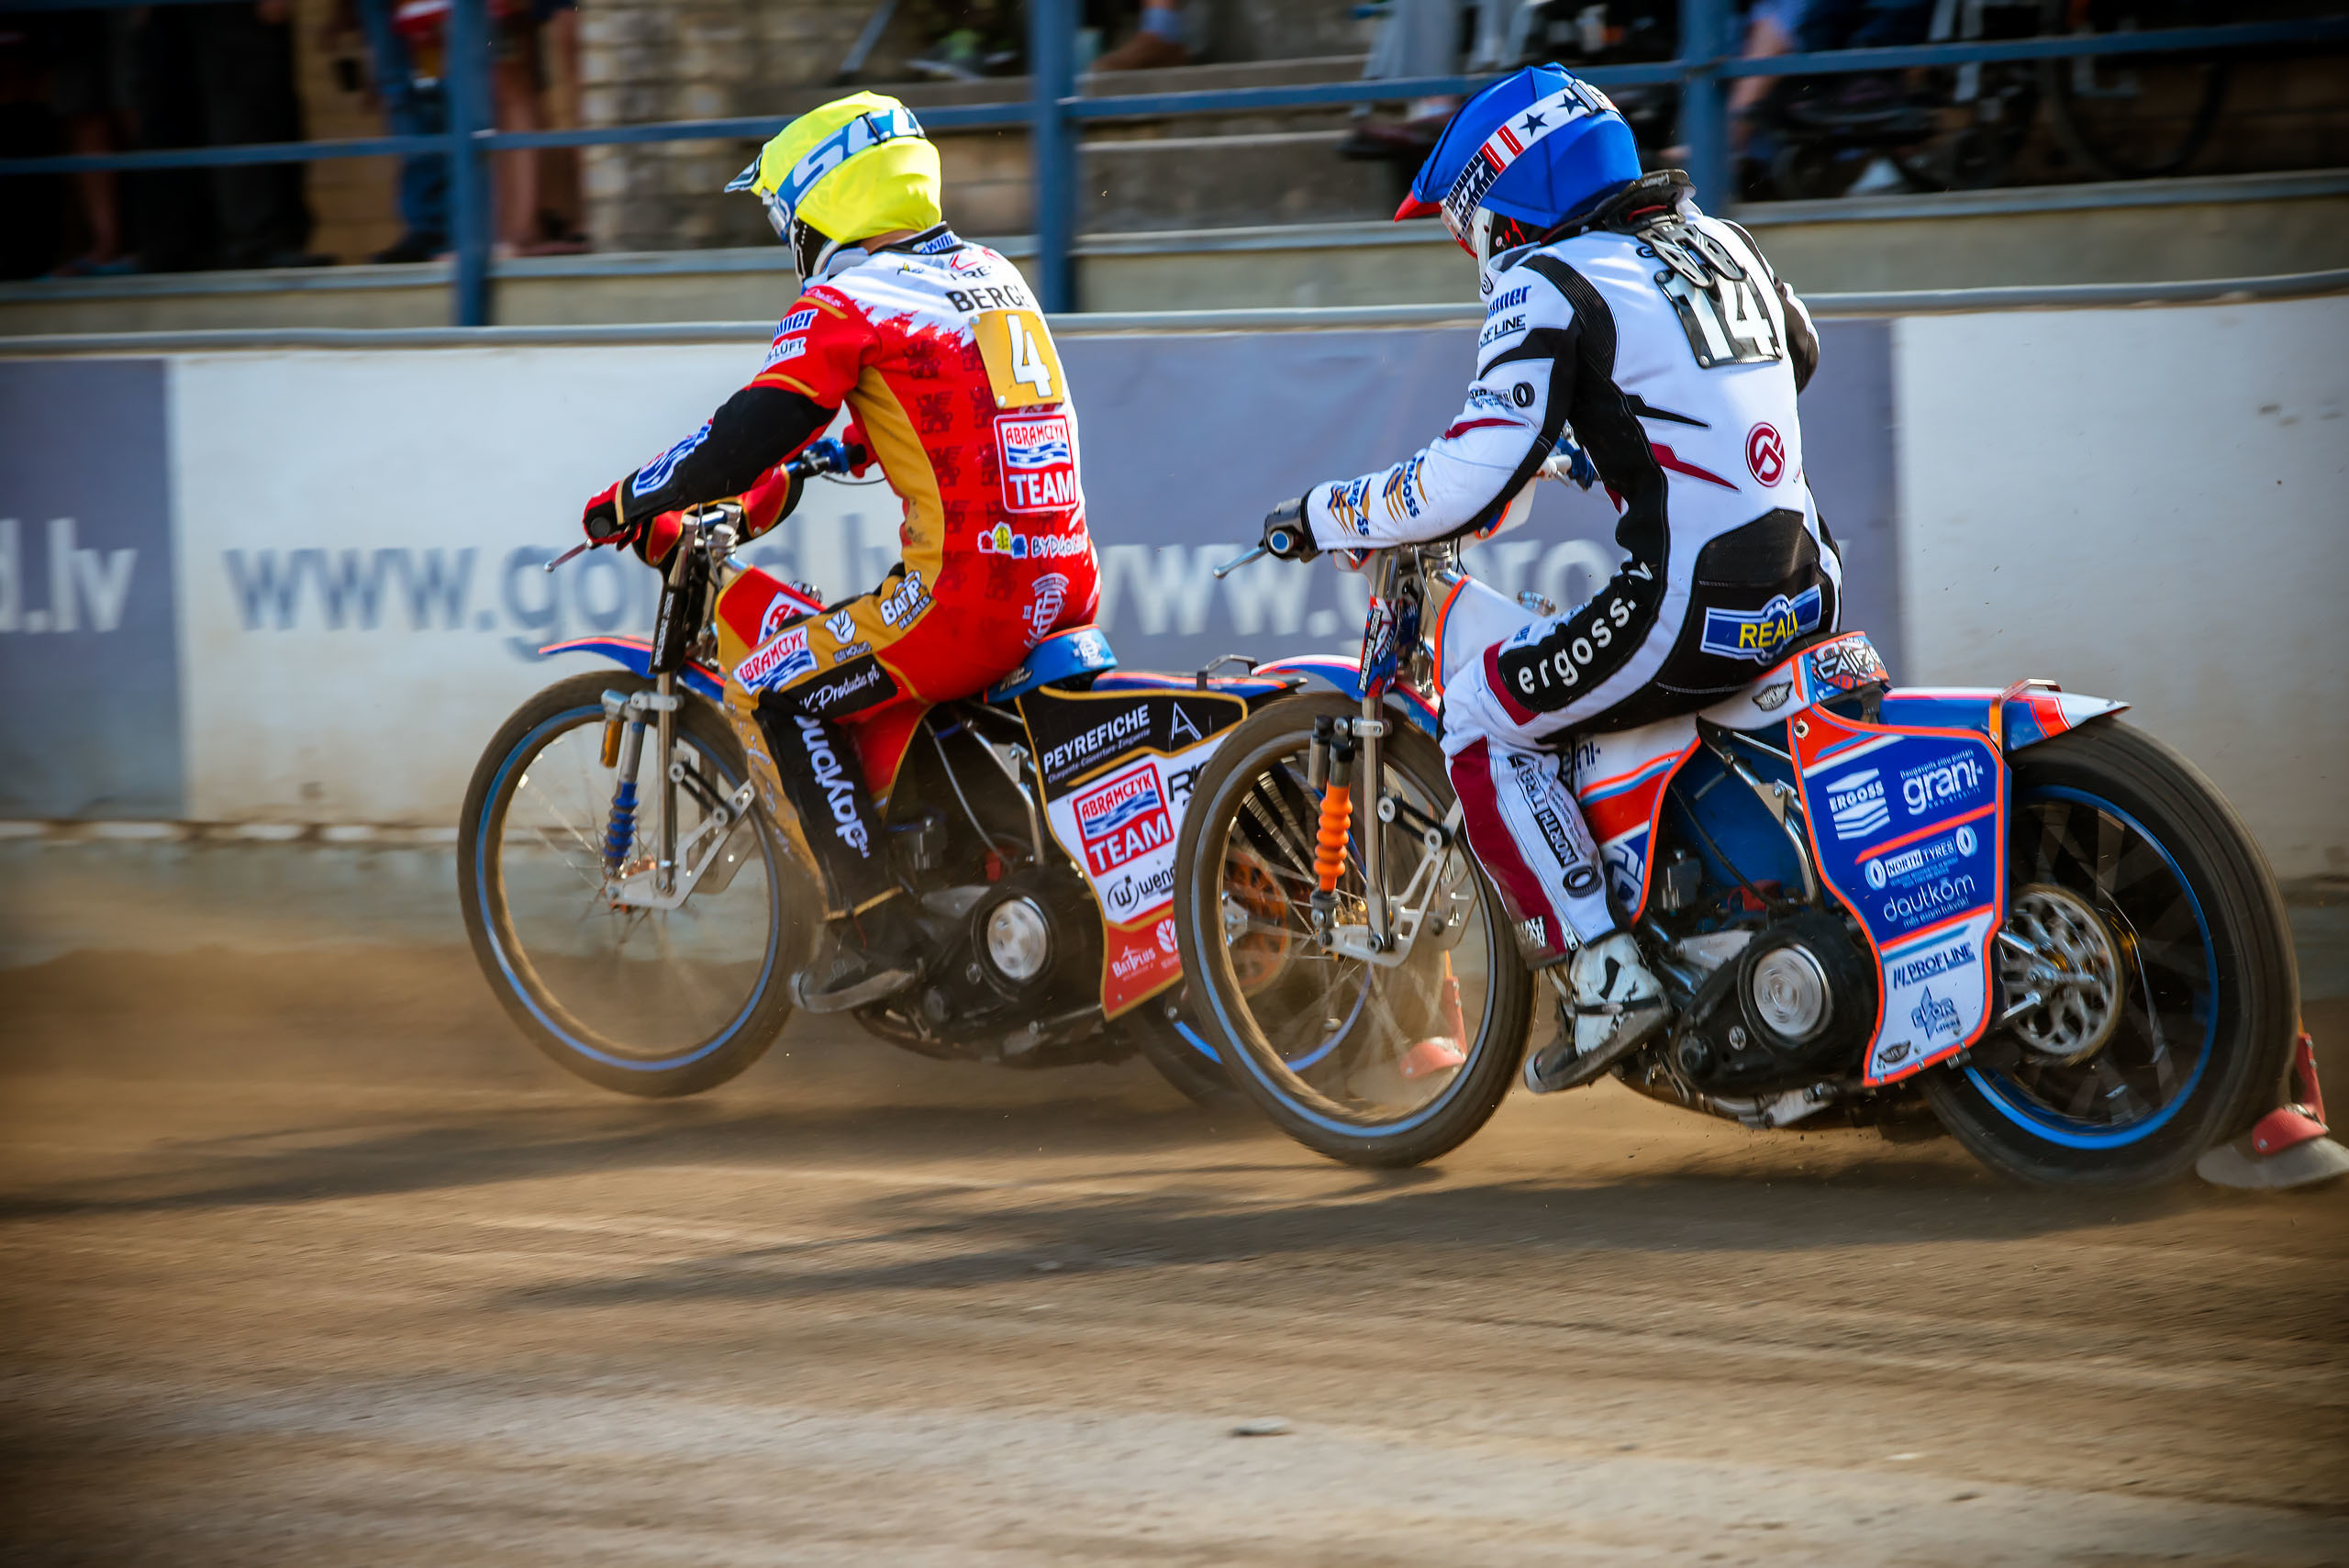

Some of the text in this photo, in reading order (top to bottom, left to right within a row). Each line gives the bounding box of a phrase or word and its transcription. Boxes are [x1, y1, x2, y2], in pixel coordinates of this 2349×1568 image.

[945, 284, 1030, 313] BERG
[1664, 272, 1777, 361] 14
[1006, 314, 1053, 397] 4
[1006, 425, 1065, 448] ABRAMCZYK
[1008, 469, 1075, 506] TEAM
[1517, 561, 1654, 695] ergoss.v
[1042, 704, 1151, 774] PEYREFICHE
[1081, 773, 1153, 821] ABRAMCZYK
[1902, 758, 1978, 816] grani
[1089, 814, 1171, 872] TEAM
[1538, 811, 1579, 867] NORTH
[1886, 851, 1923, 878] NORTH
[1923, 841, 1955, 863] TYRES
